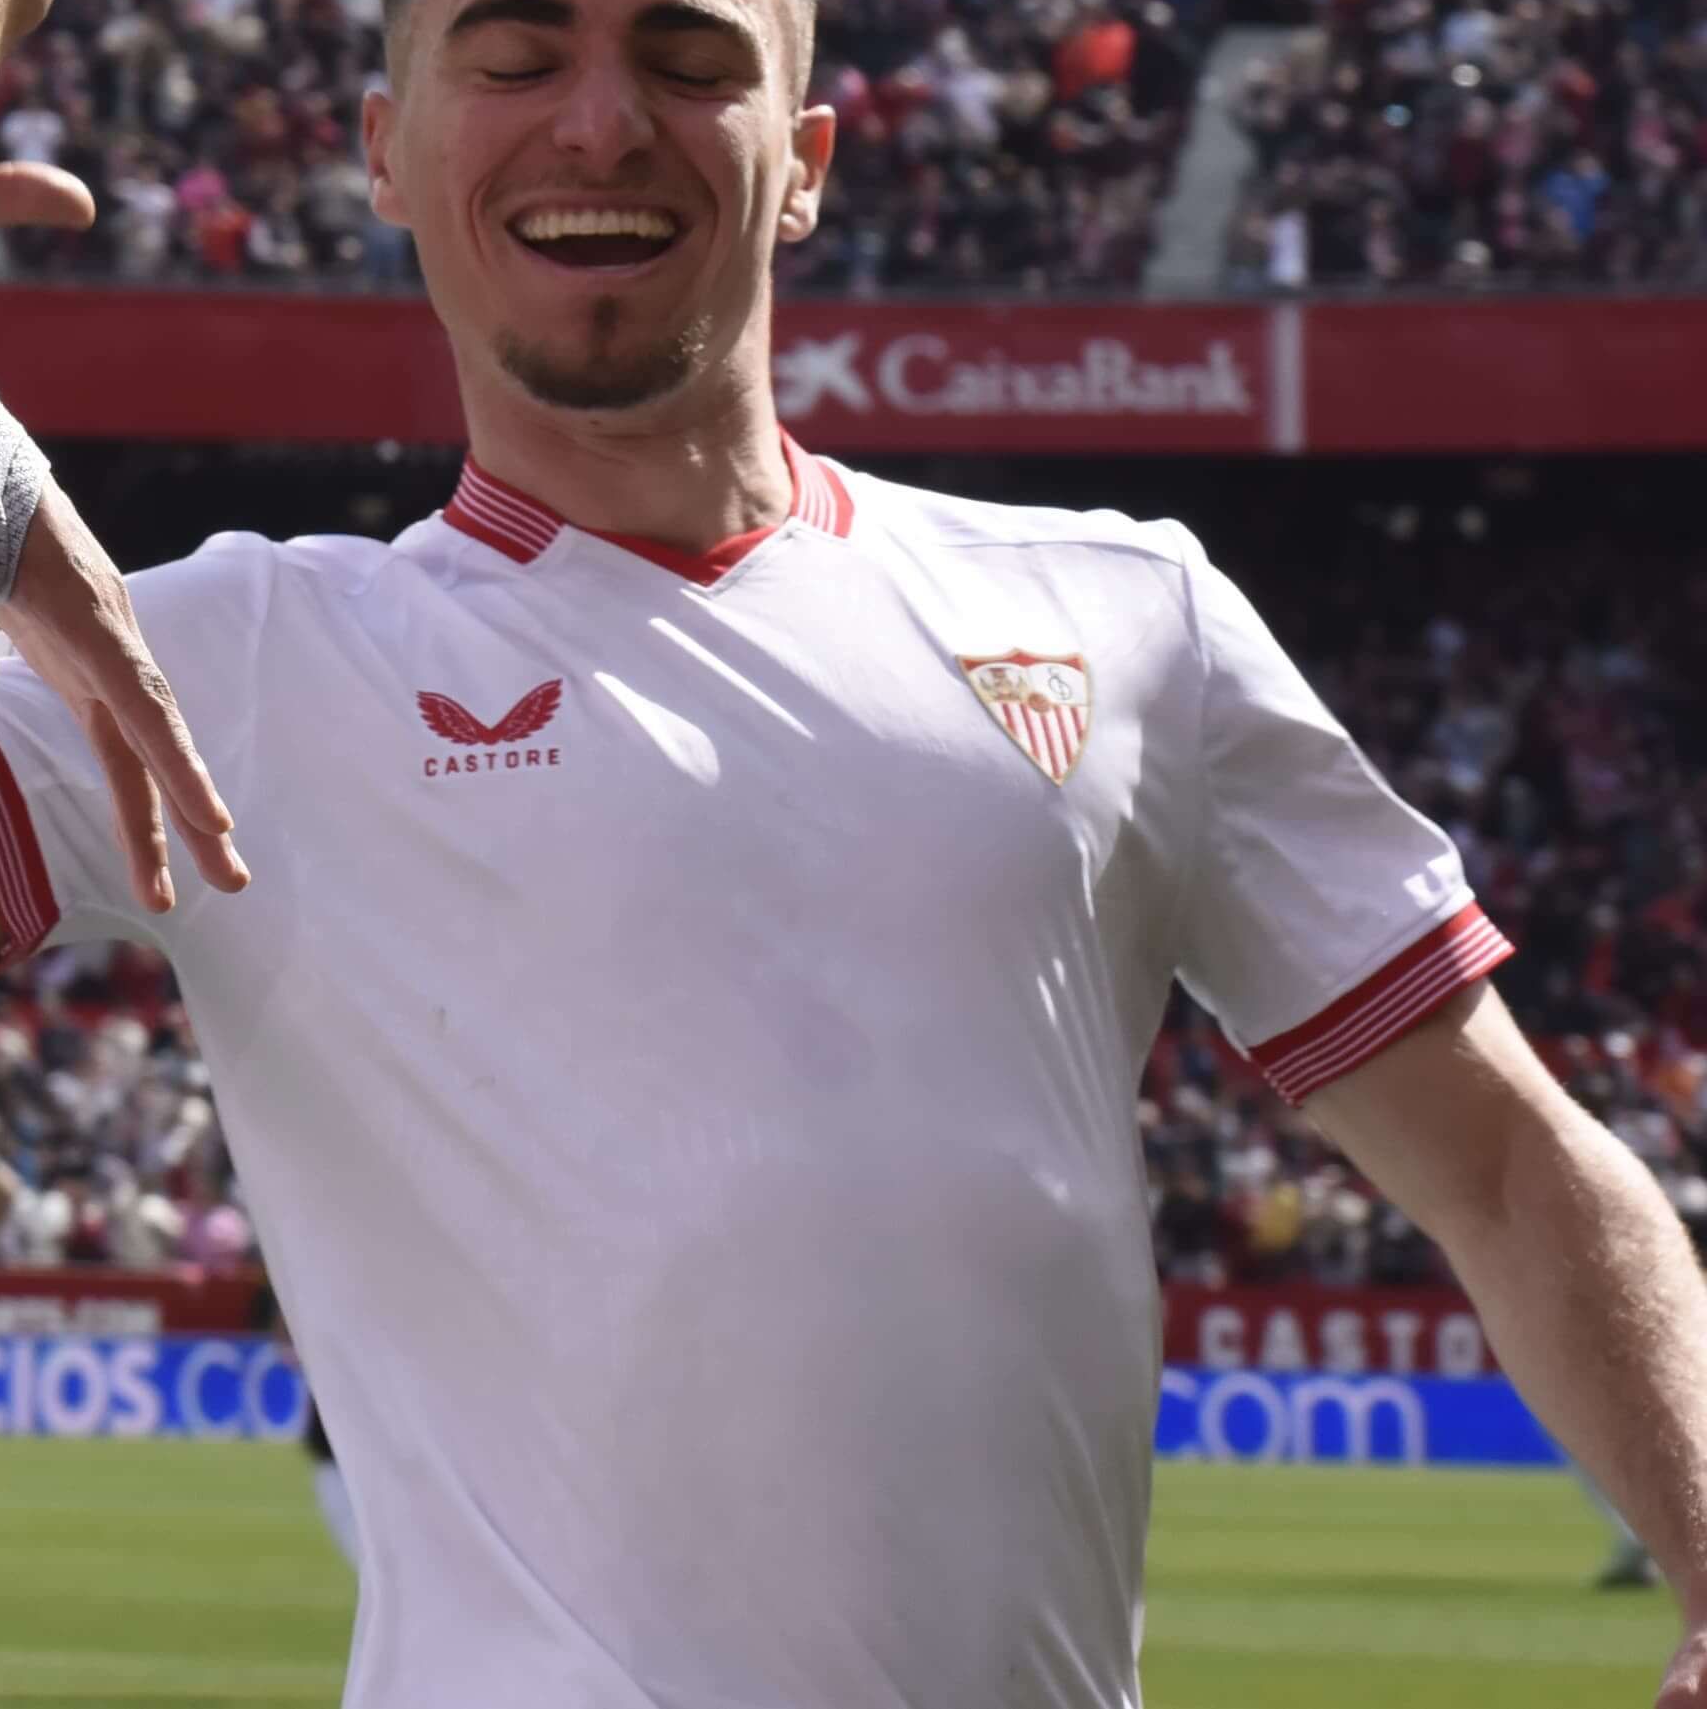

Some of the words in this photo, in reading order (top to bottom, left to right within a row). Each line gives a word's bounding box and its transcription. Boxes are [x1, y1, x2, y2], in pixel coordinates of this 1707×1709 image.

[877, 334, 1250, 415] CaixaBank
[424, 748, 561, 777] CASTORE
[1199, 1306, 1484, 1380] CASTO
